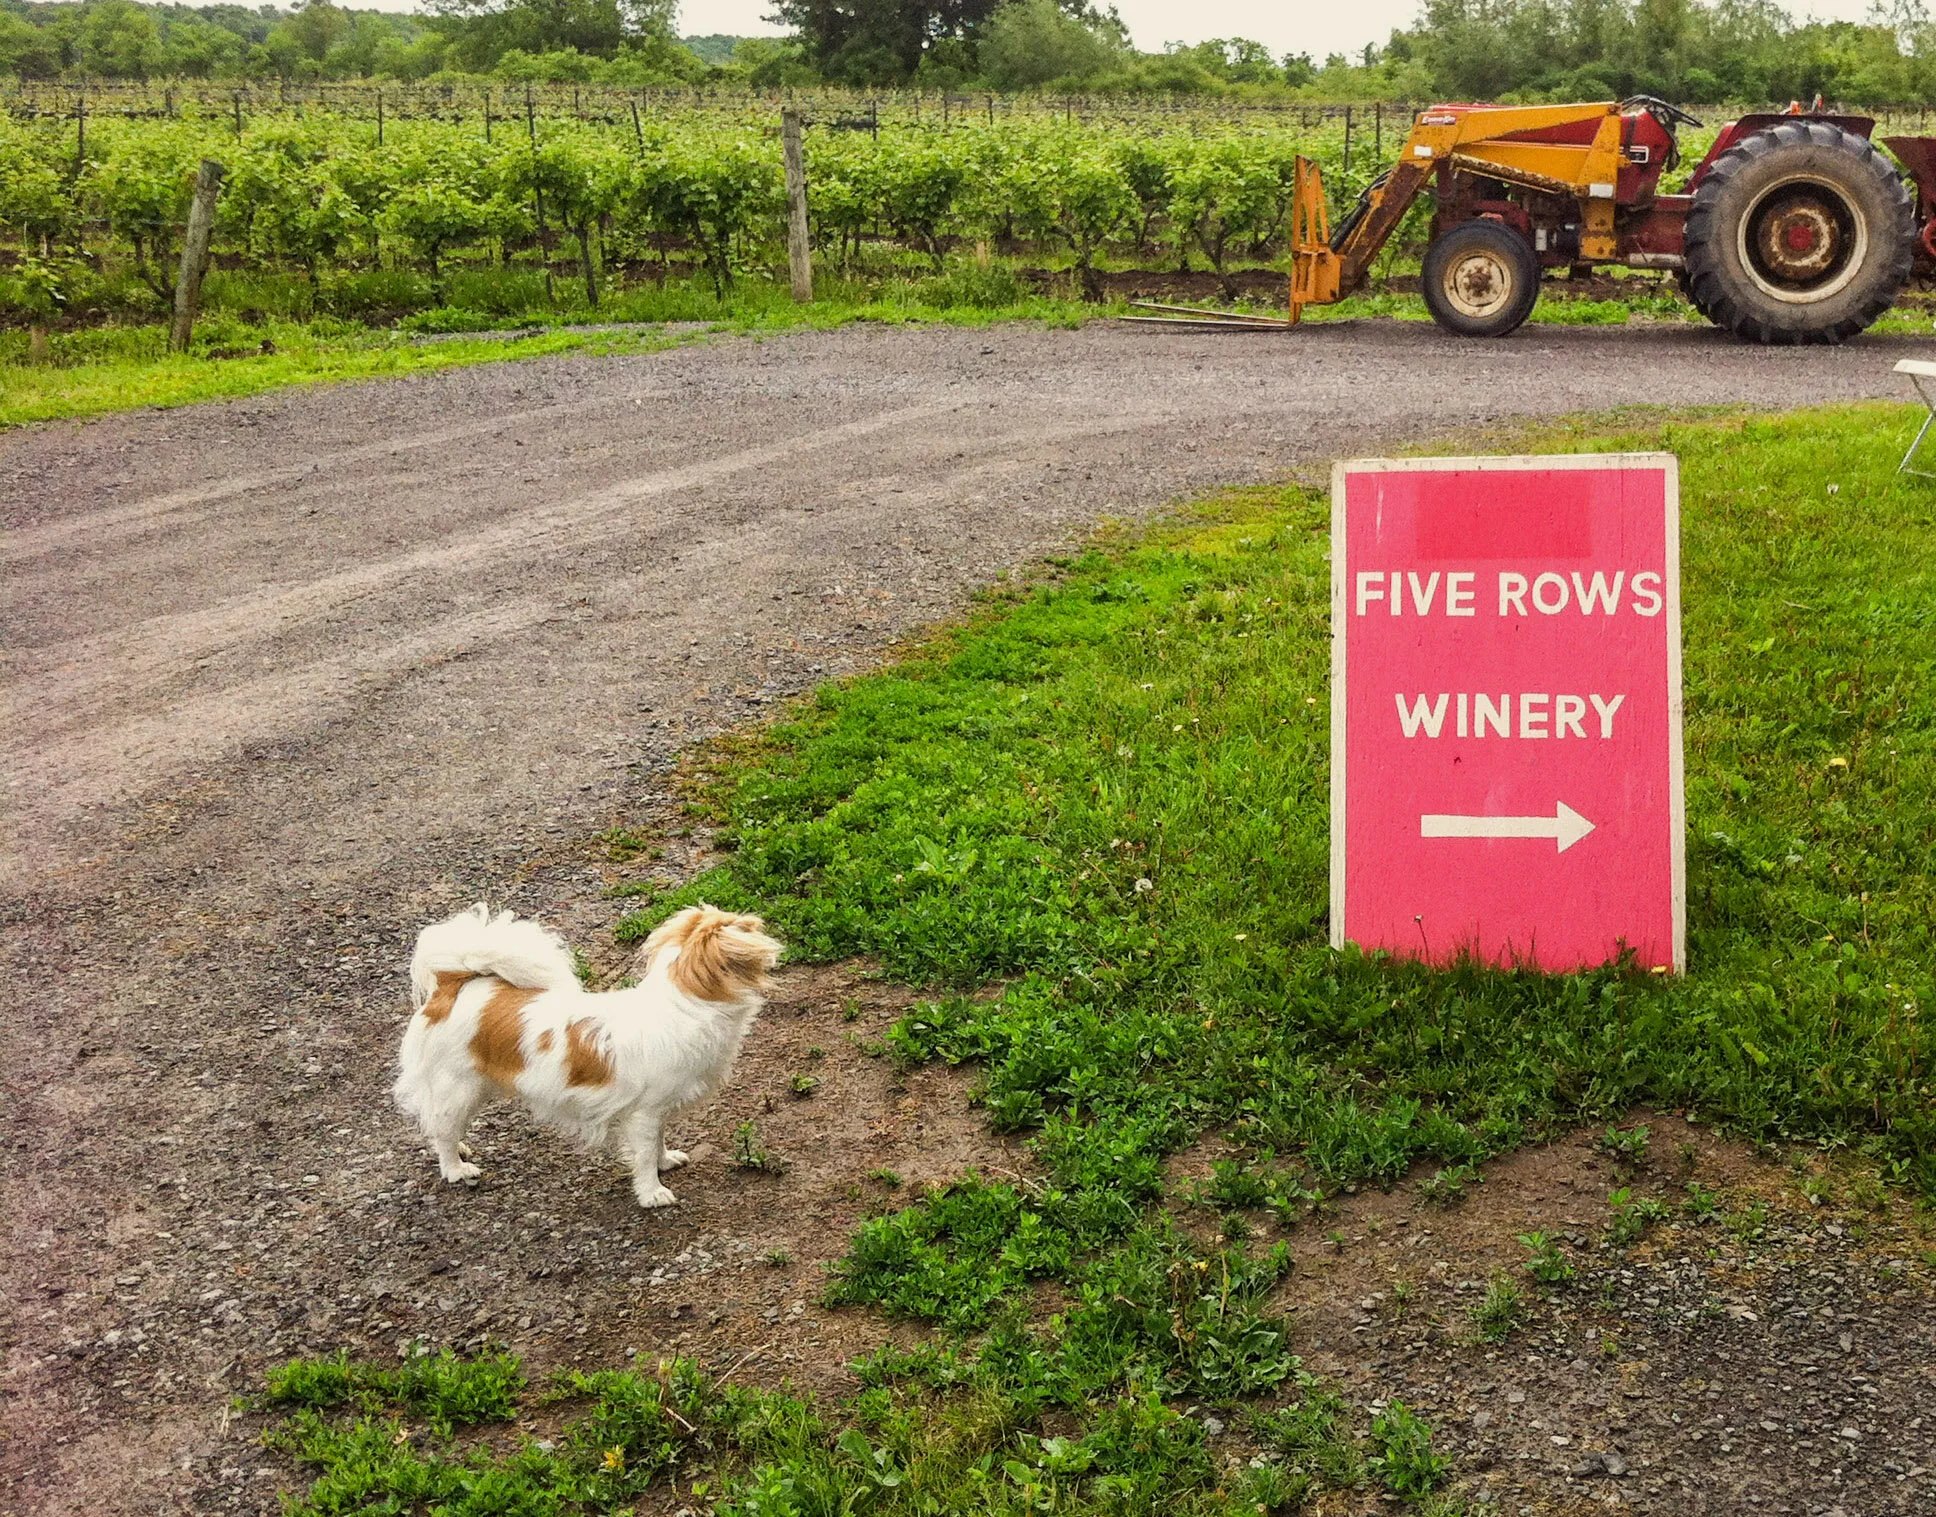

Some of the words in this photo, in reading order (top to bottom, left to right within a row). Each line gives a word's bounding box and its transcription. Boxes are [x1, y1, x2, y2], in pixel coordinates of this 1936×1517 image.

[1357, 571, 1476, 617] FIVE
[1498, 571, 1663, 617] ROWS
[1395, 693, 1626, 739] WINERY
